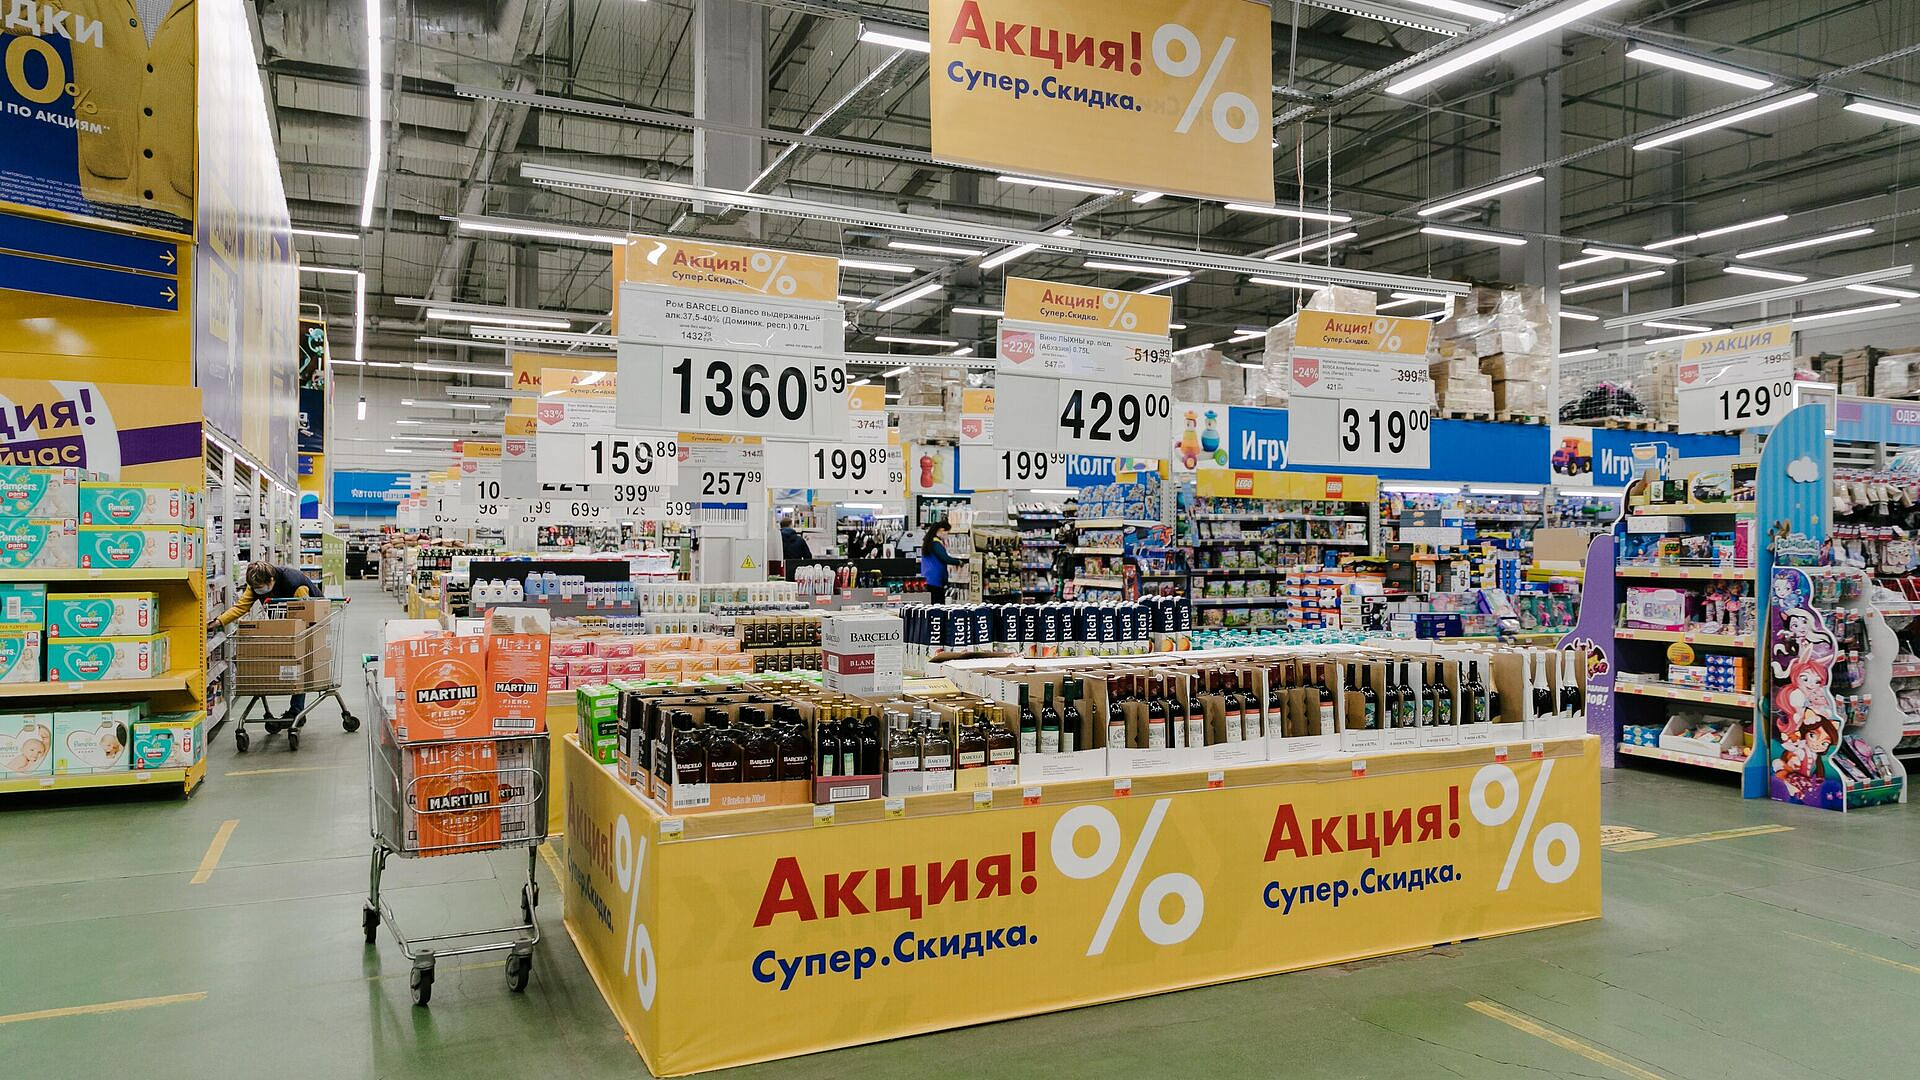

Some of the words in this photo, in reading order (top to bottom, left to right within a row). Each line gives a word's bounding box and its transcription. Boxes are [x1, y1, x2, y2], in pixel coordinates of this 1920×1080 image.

[948, 0, 1142, 76] Акция!
[947, 61, 1142, 112] Супер.Скидка.
[7, 103, 32, 118] ПО
[672, 249, 748, 272] Акция!
[665, 300, 684, 309] Ром
[686, 302, 729, 313] BARCELO
[1041, 289, 1100, 310] Акция!
[1040, 308, 1099, 322] Супер.Скидка.
[1325, 318, 1373, 335] Акция!
[681, 331, 703, 341] 1432
[1039, 333, 1057, 342] Вино
[1323, 336, 1370, 345] Супер.Скидка.
[1714, 331, 1773, 353] АКЦИЯ
[1003, 341, 1034, 354] -22%
[1134, 348, 1159, 363] 519
[1159, 348, 1170, 357] 99
[1044, 361, 1058, 369] 547
[1765, 354, 1782, 364] 199
[1294, 367, 1319, 379] -24%
[1397, 369, 1418, 382] 399
[672, 358, 808, 421] 1360
[813, 365, 846, 394] 59
[1326, 383, 1337, 391] 421
[1720, 386, 1771, 420] 129
[1773, 381, 1792, 398] 00
[538, 409, 564, 419] -33%
[1060, 389, 1141, 443] 429
[1145, 393, 1170, 418] 00
[857, 420, 875, 430] 374
[1342, 408, 1406, 454] 319
[1409, 410, 1429, 431] 00
[591, 440, 654, 475] 159
[656, 441, 677, 458] 89
[1242, 429, 1289, 470] Игру
[814, 448, 867, 480] 199
[869, 448, 887, 464] 89
[1002, 451, 1048, 480] 199
[702, 471, 746, 496] 257
[747, 471, 762, 483] 99
[889, 471, 903, 483] 99
[1236, 478, 1253, 489] LEGO
[478, 481, 500, 500] 10
[614, 485, 648, 502] 399
[1327, 483, 1342, 492] LEGO
[108, 502, 135, 511] Pampers
[666, 502, 692, 516] 599
[107, 545, 134, 554] Pampers
[75, 614, 103, 623] Pampers
[1086, 613, 1096, 640] Rich
[1138, 613, 1147, 639] Rich
[1164, 606, 1174, 632] Rich
[1180, 605, 1190, 630] Rich
[930, 616, 941, 644] Rich
[954, 616, 965, 645] Rich
[977, 615, 989, 643] Rich
[1006, 614, 1017, 641] Rich
[1025, 614, 1034, 641] Rich
[1045, 614, 1056, 641] Rich
[1062, 614, 1072, 640] Rich
[1102, 615, 1114, 641] Rich
[1121, 614, 1131, 640] Rich
[850, 630, 900, 643] BARCELÓ
[75, 659, 103, 667] Pampers
[418, 686, 476, 702] MARTINI
[496, 683, 537, 692] MARTINI
[431, 709, 466, 718] FIERO
[677, 762, 703, 770] BARCELÓ
[711, 760, 738, 768] BARCELÓ
[430, 793, 488, 810] MARTINI
[442, 816, 478, 826] FIERO
[1263, 785, 1461, 862] Акция!
[568, 781, 614, 884] Акция!
[752, 831, 1039, 928] Акция!
[1263, 863, 1462, 916] Супер.Скидка.
[751, 926, 1039, 991] Супер.Скидка.
